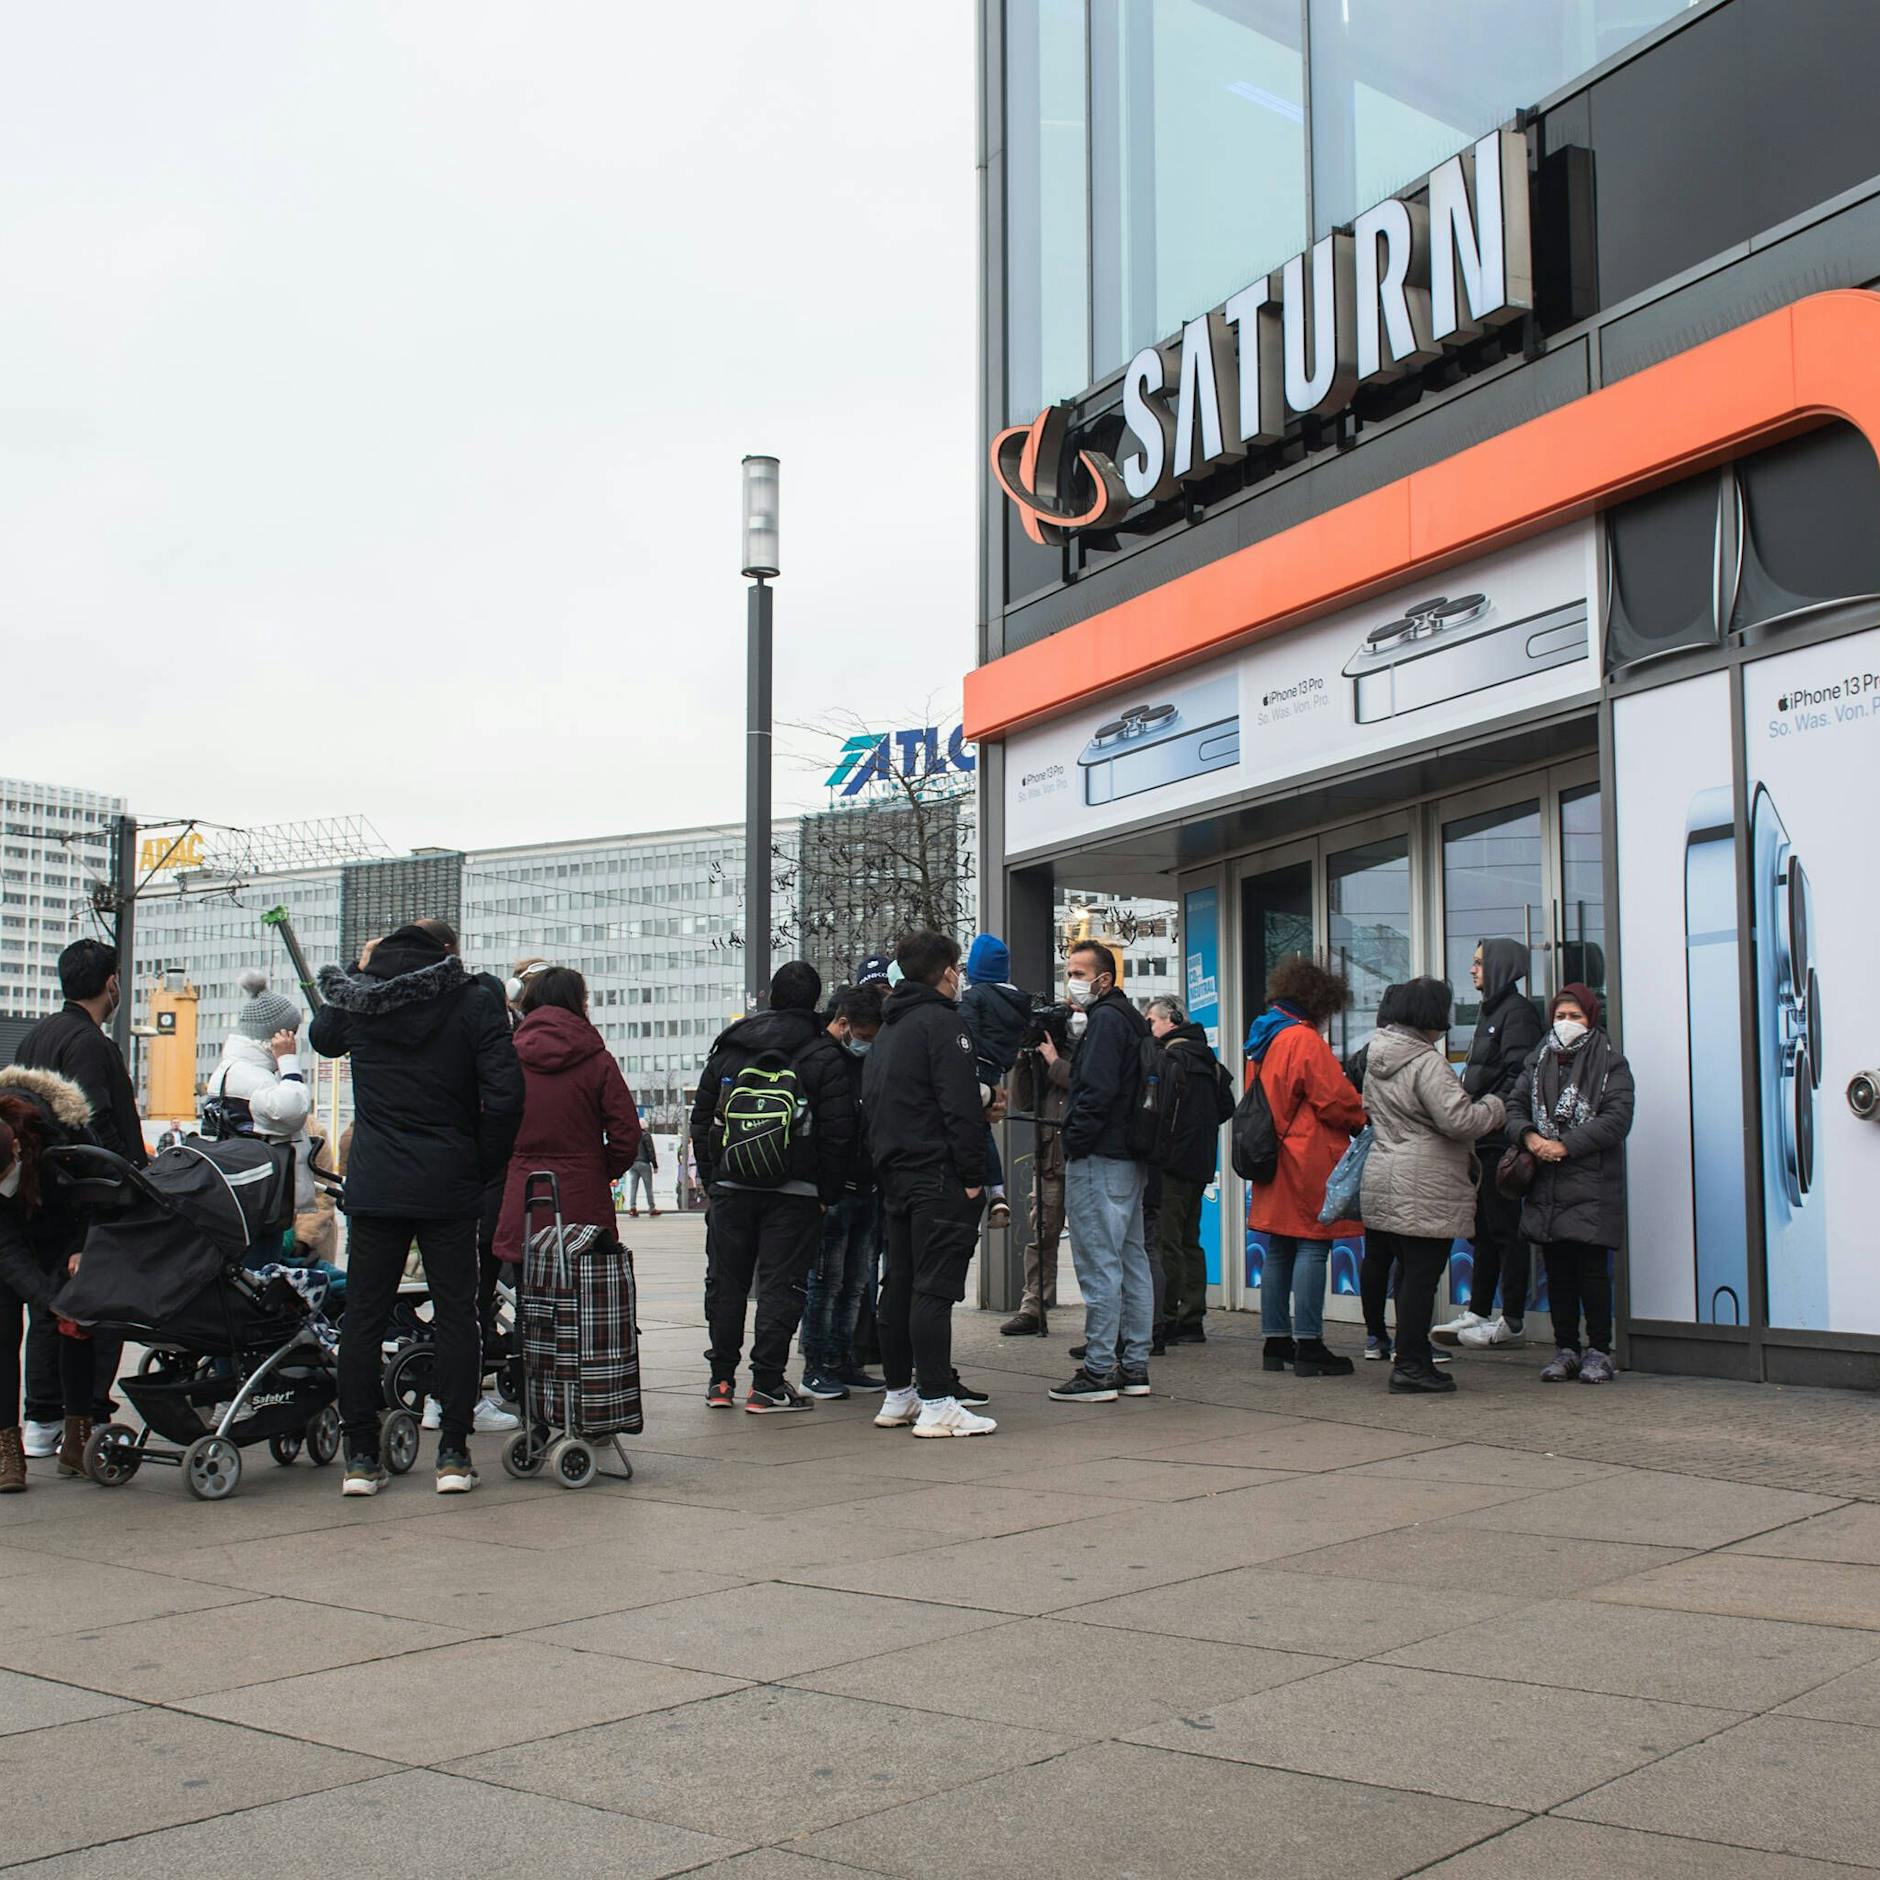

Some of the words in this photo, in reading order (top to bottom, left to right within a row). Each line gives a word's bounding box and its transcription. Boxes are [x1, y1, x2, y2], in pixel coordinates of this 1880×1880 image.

[1122, 128, 1510, 500] SATURN
[1268, 687, 1298, 705] iPhone
[1298, 680, 1308, 695] 13
[1308, 678, 1324, 691] Pro
[1789, 685, 1841, 709] iPhone
[1843, 676, 1860, 696] 13
[1863, 673, 1880, 692] Pr
[1768, 720, 1792, 738] So.
[1795, 712, 1831, 732] Was.
[1834, 703, 1869, 723] Von.
[139, 832, 204, 871] ADAC
